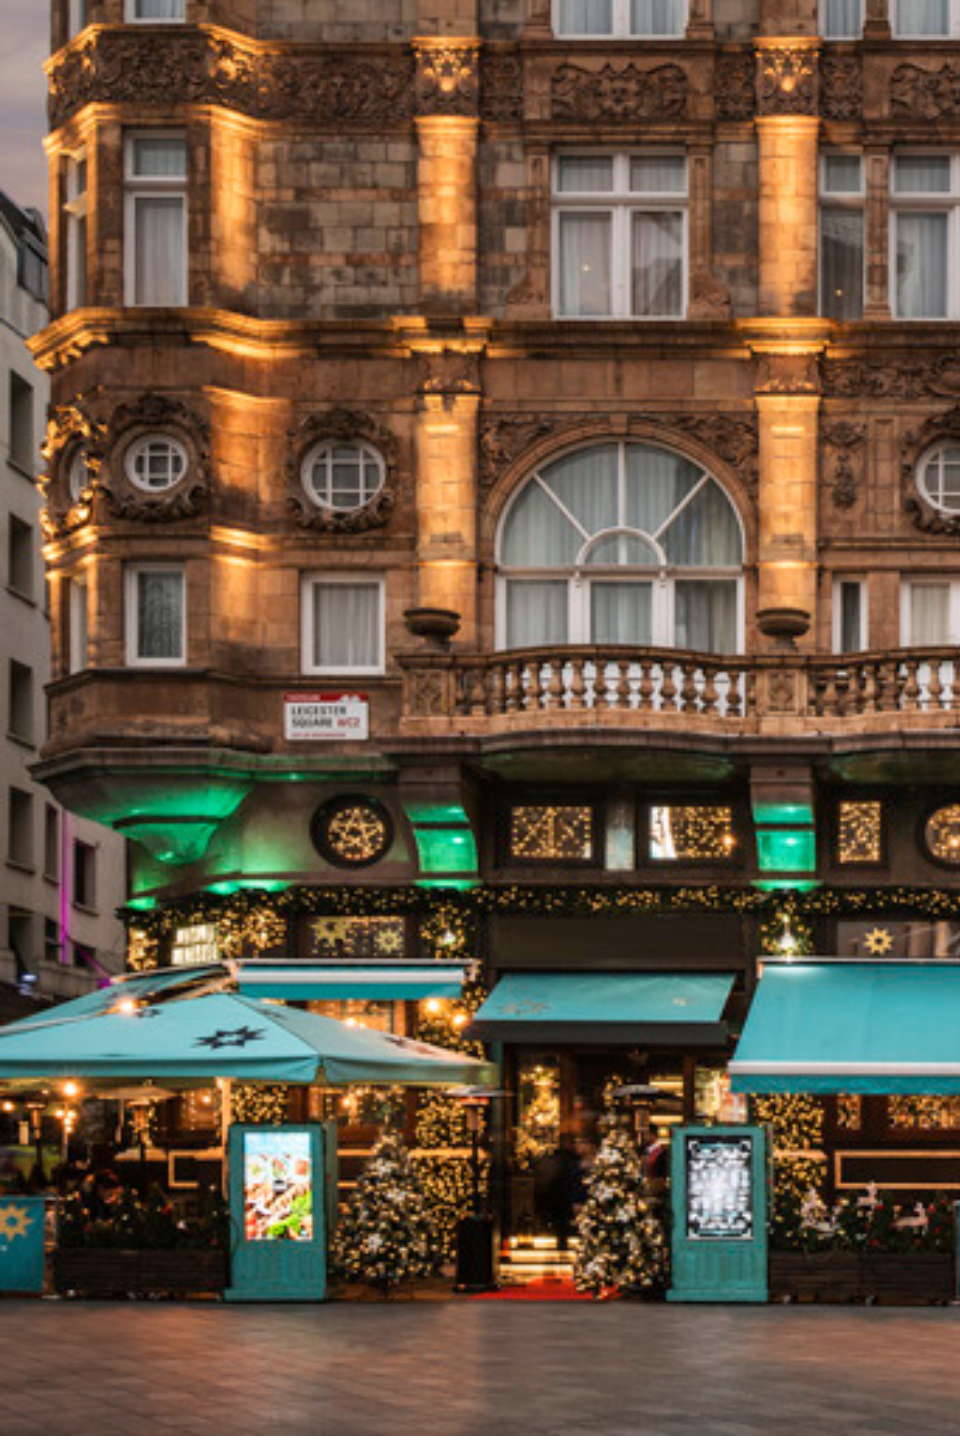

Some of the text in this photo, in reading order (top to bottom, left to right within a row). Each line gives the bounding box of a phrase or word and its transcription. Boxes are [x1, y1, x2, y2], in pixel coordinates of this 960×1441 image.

[291, 705, 346, 715] LEICESTER
[291, 717, 360, 728] SQUARE WC2
